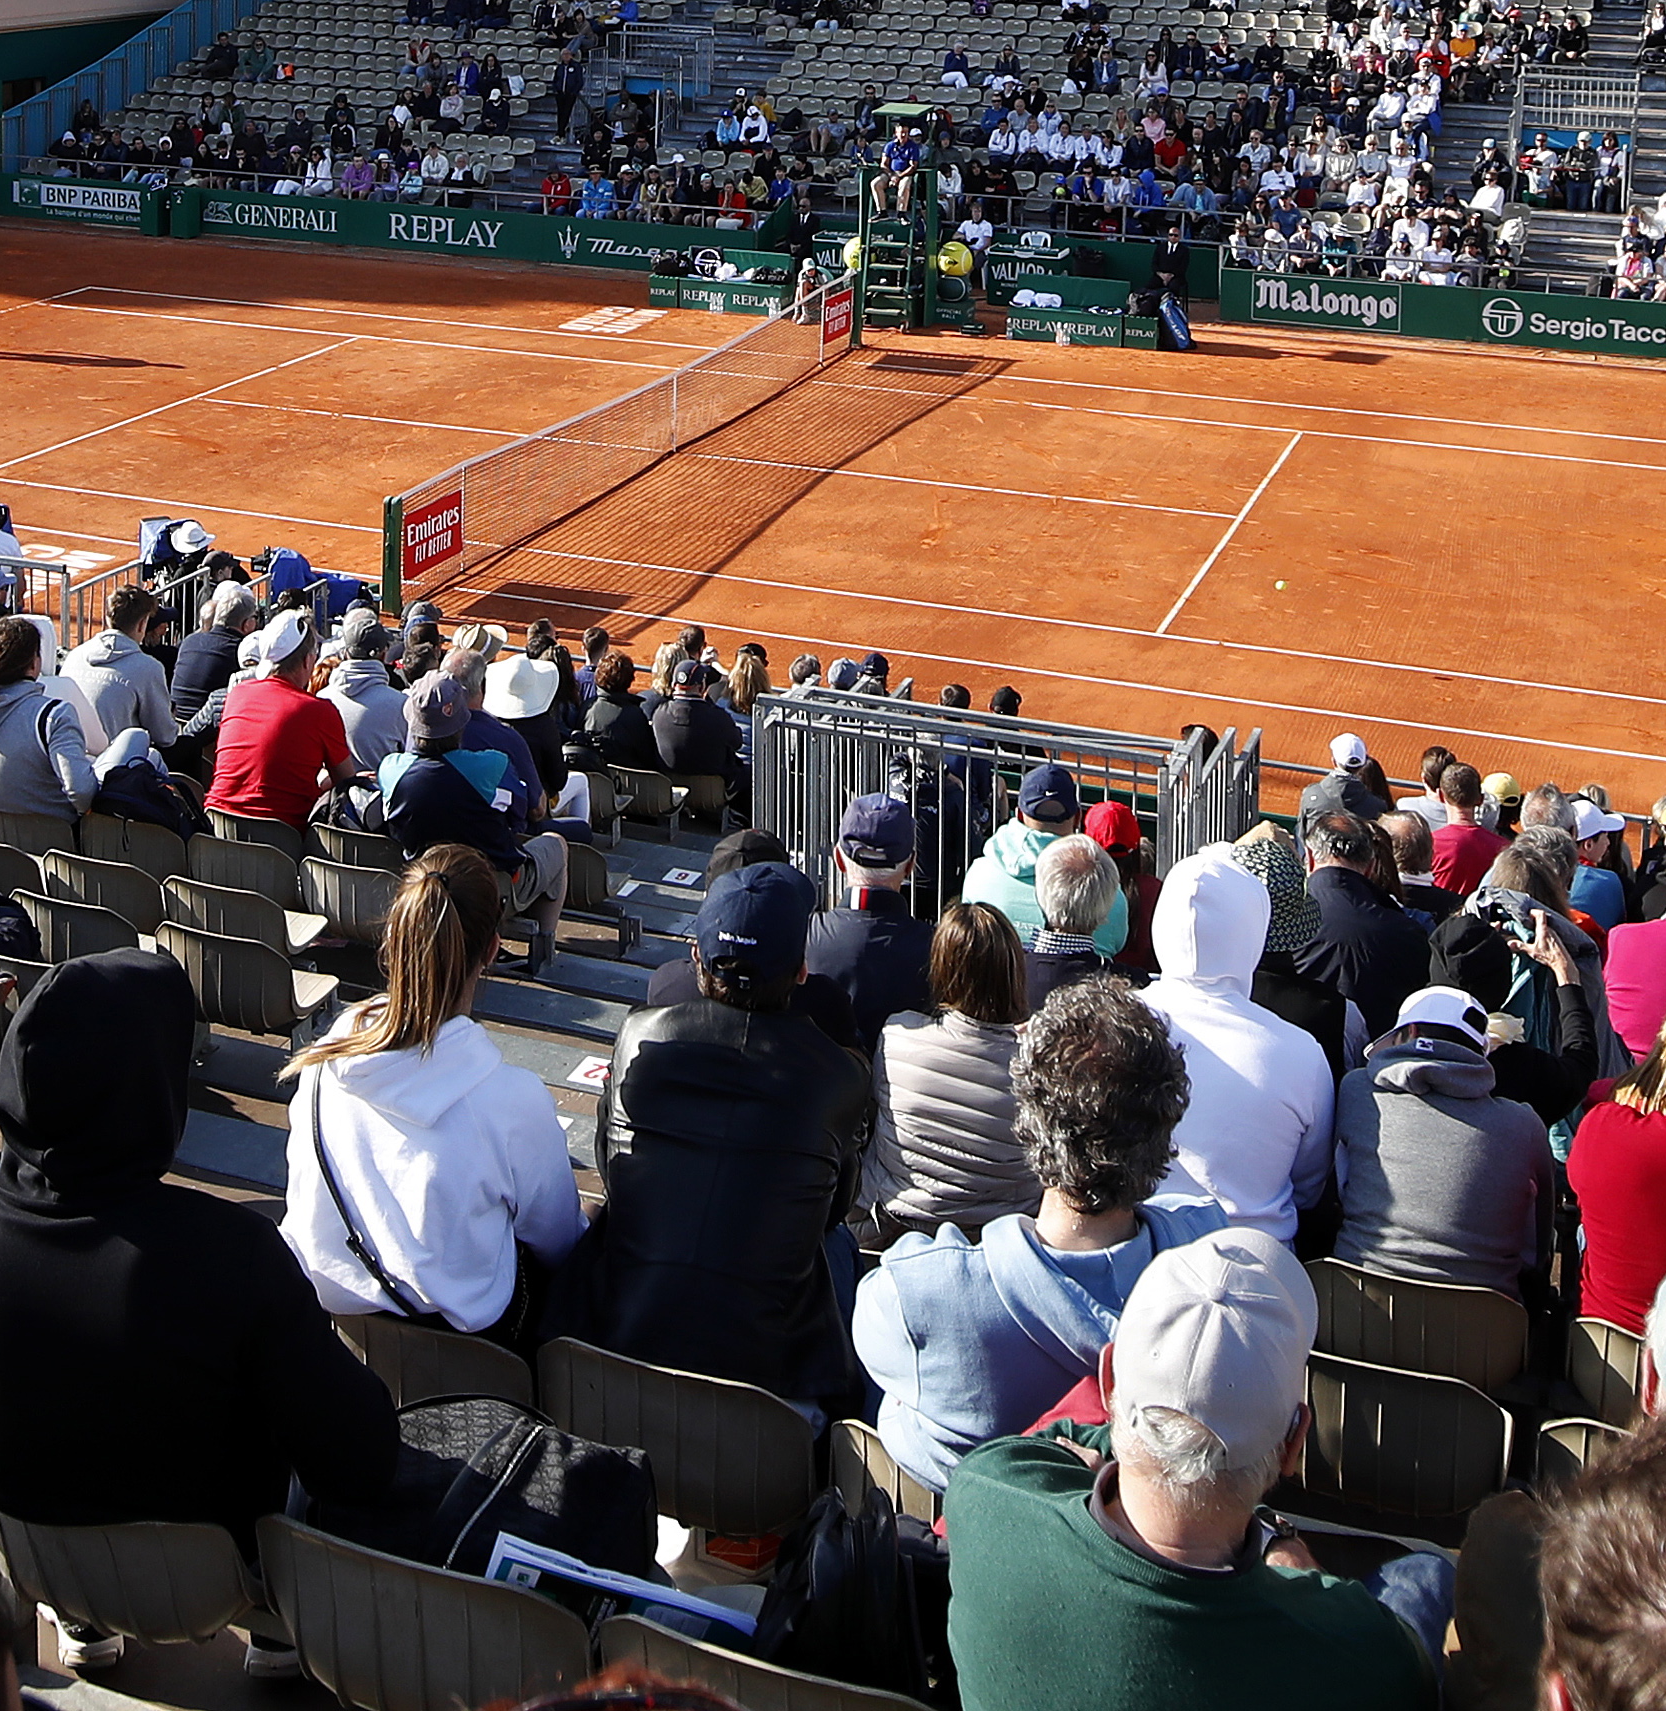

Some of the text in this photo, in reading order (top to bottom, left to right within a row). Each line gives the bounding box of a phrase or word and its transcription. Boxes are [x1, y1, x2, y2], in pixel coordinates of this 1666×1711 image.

[46, 187, 141, 210] BNP PARIBA
[146, 193, 151, 201] 1
[176, 196, 182, 204] 2
[235, 203, 338, 233] GENERALI
[389, 213, 504, 249] REPLAY
[650, 288, 676, 297] REPLAY
[1255, 278, 1398, 327] Malongo
[1068, 323, 1117, 339] REPLAY
[1125, 329, 1155, 339] REPLAY
[1529, 312, 1606, 341] Sergio
[407, 506, 460, 547] Emirates
